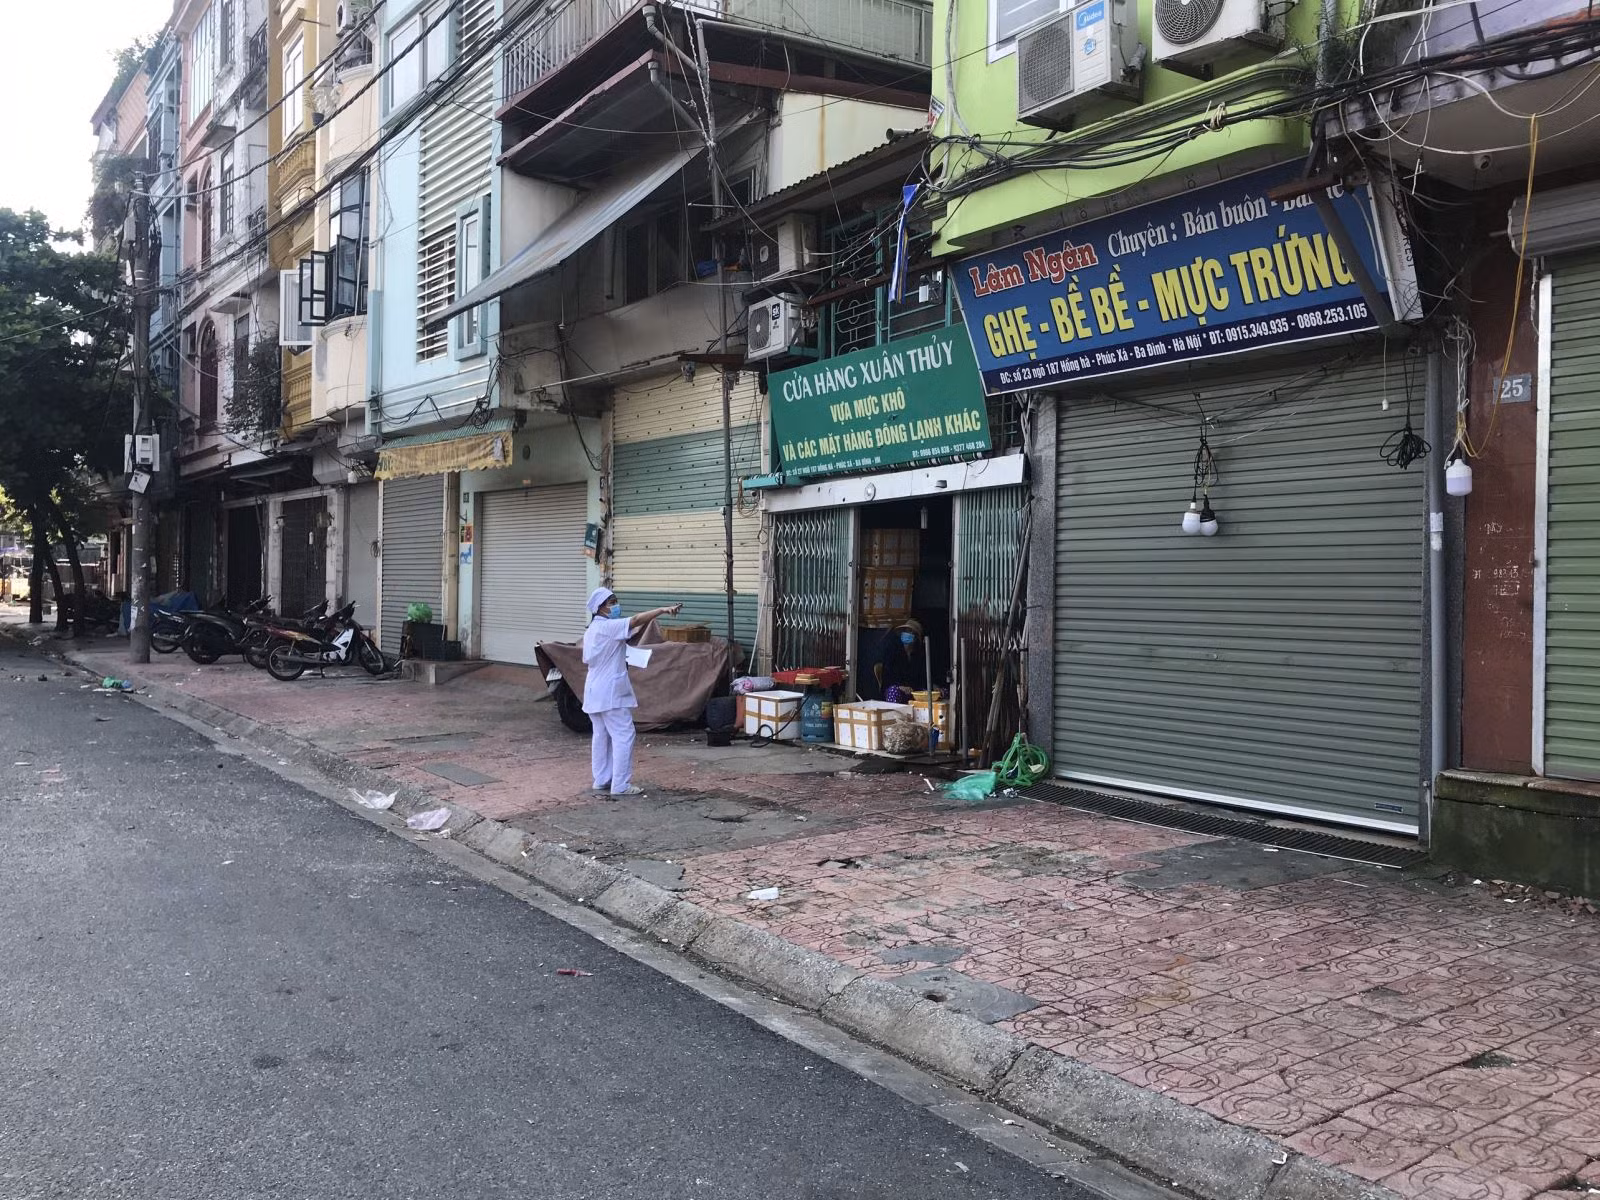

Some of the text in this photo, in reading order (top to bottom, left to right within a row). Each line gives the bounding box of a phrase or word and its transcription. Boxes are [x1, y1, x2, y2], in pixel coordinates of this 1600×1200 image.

[1182, 206, 1219, 238] Bán
[1218, 193, 1268, 228] buôn
[969, 240, 1099, 297] Lâm Ngân
[983, 305, 1038, 361] GHẸ
[1049, 274, 1093, 343] BỀ
[1090, 264, 1134, 335] BỀ
[1151, 256, 1230, 326] MỰC
[783, 335, 953, 402] CỬA HÀNG XUÂN THỦY
[1022, 368, 1032, 380] 23
[1032, 363, 1046, 379] ngõ
[1046, 361, 1060, 375] 187
[1060, 357, 1080, 373] Hồng
[1080, 355, 1091, 369] hà
[1095, 350, 1117, 366] Phúc
[1116, 347, 1129, 362] Xá
[1134, 345, 1147, 359] Ba
[1172, 337, 1186, 352] Hà
[1185, 334, 1202, 352] Nội
[1208, 329, 1225, 345] ĐT:
[1226, 317, 1289, 342] 0915.349.935
[1296, 302, 1368, 329] 0868.253.105
[830, 386, 906, 425] VỰA MỰC KHÔ
[1501, 378, 1523, 398] 25
[782, 407, 981, 461] VÀ CÁC MẶT HÀNG ĐÔNG LẠNH KHÁC
